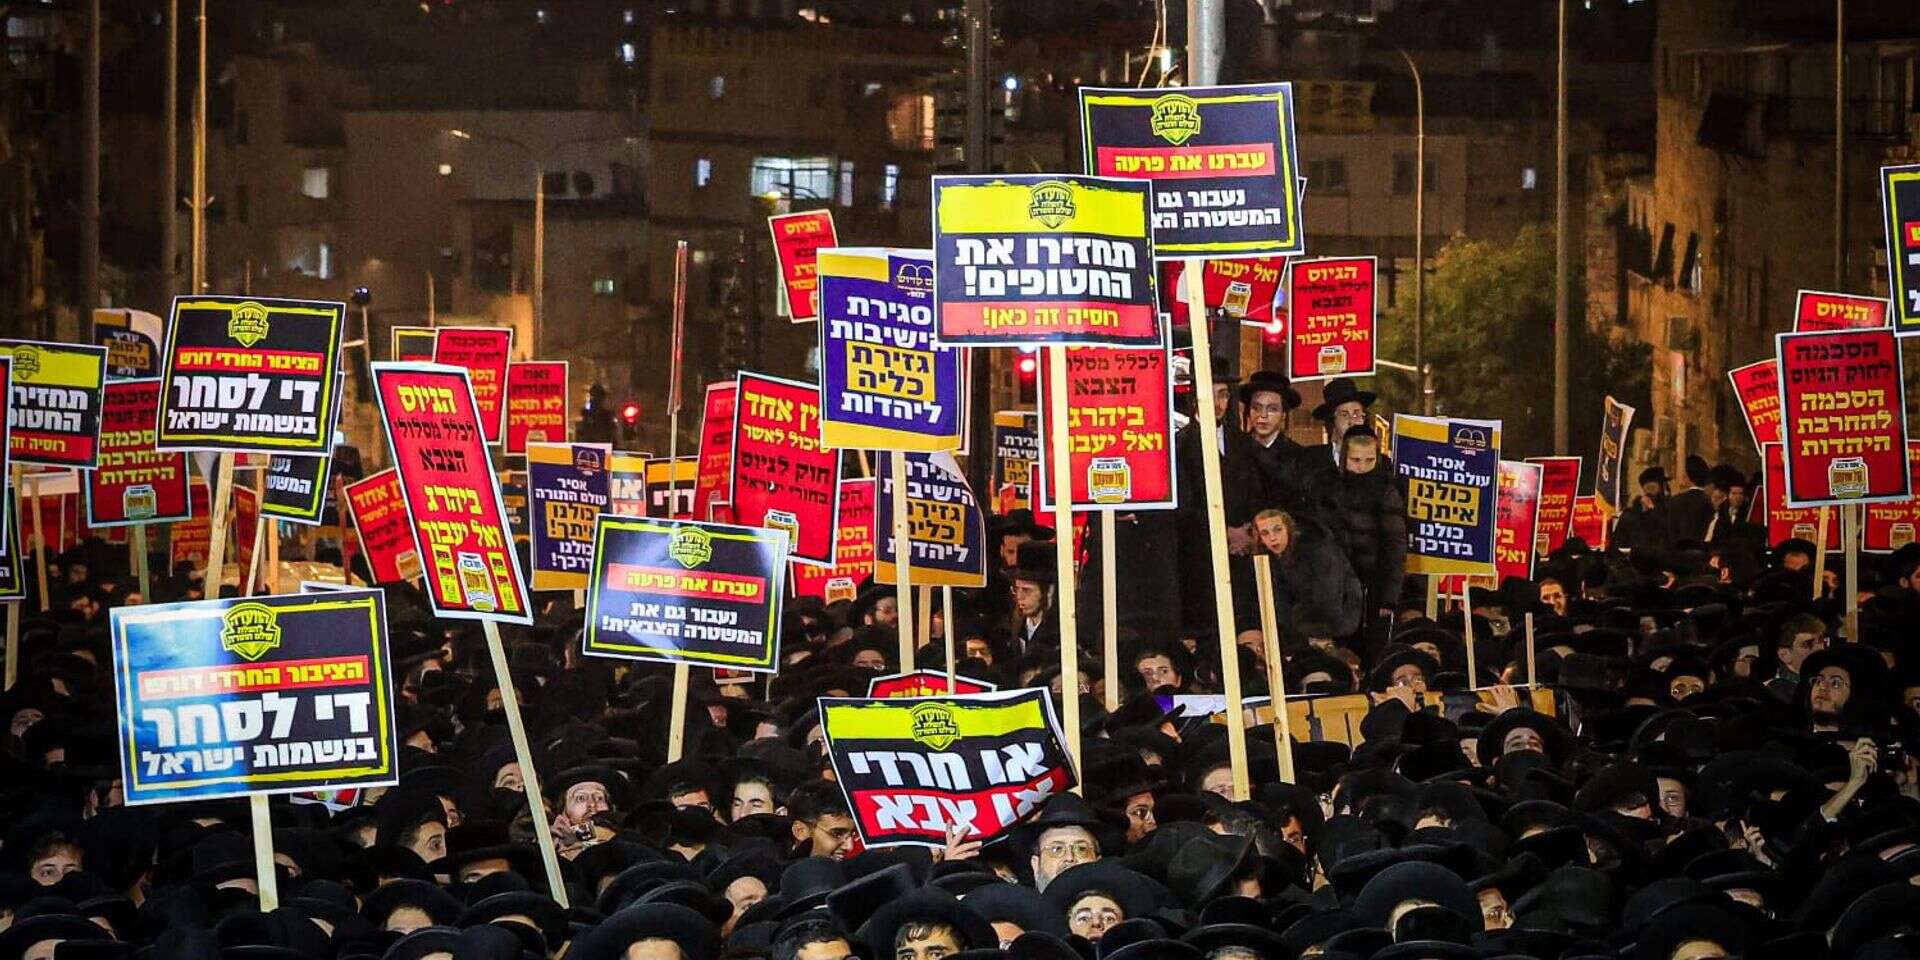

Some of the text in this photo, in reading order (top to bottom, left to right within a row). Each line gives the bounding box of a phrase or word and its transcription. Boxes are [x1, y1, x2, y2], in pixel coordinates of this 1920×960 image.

[1115, 152, 1266, 173] עברנו את פרעה
[1158, 189, 1245, 208] נעבור גם
[1183, 208, 1281, 229] המשטרה
[955, 238, 1137, 268] תחזירו את
[965, 265, 1133, 299] החטופים!
[1209, 260, 1278, 283] ואל יעבור
[1307, 265, 1360, 282] הגיוס
[847, 295, 932, 326] סגירת
[983, 307, 1119, 330] רוסיה זה כאן!
[1307, 312, 1358, 330] ביהרג
[1816, 302, 1870, 321] הגיוס
[1296, 329, 1369, 346] ואל יעבור
[179, 351, 320, 370] הציבור החרדי דורש
[852, 345, 930, 373] גזירת
[1066, 353, 1159, 372] לכלל מסלו
[1795, 341, 1879, 361] הסכמה
[859, 369, 924, 395] כליה
[1791, 360, 1892, 384] לחוק הגיוס
[173, 373, 270, 410] לסחר
[279, 380, 320, 412] די
[1074, 377, 1136, 395] הצבא
[397, 384, 457, 414] הגיוס
[543, 395, 562, 411] לא
[841, 392, 942, 424] ליהדות
[1801, 389, 1885, 412] הסכמה
[167, 409, 229, 430] ישראל
[744, 390, 820, 432] ין אחד
[1069, 405, 1145, 428] ביהרג
[1797, 410, 1892, 434] להחרבת
[233, 413, 317, 434] בנשמות
[394, 417, 475, 441] לכלל מסלולי
[29, 439, 66, 452] רוסיה
[101, 429, 155, 448] סכמה
[741, 423, 831, 454] יכול לאשר
[1004, 435, 1038, 448] גירת
[1069, 430, 1163, 454] ואל יעבו
[1801, 435, 1891, 456] היהדות
[419, 447, 468, 473] הצבא
[998, 446, 1038, 459] שיבות
[1427, 455, 1466, 471] אסיר
[100, 467, 176, 485] היהדות
[741, 450, 830, 484] חוק לגיוס
[1399, 463, 1490, 487] עולם התורה
[266, 475, 311, 494] המשט
[557, 478, 587, 492] אסיר
[1417, 481, 1472, 504] כולנו
[535, 488, 607, 506] עולם התורה
[553, 503, 594, 521] כולנו
[1412, 497, 1475, 522] איתך!
[418, 519, 469, 547] יעבור
[470, 520, 504, 549] ואל
[551, 519, 593, 541] יתך!
[1419, 522, 1464, 540] כולנו
[1409, 534, 1474, 556] בדרכך!
[1497, 545, 1527, 564] ואל
[551, 552, 591, 570] רכך!
[627, 571, 758, 597] עברנו את פרעה
[630, 602, 738, 626] נעבור גם את
[602, 615, 762, 646] המשטרה הצבאית!
[144, 661, 364, 694] הציבור החרדי דורש
[142, 692, 371, 748] די לסחר
[143, 737, 378, 776] בנשמות ישראל
[848, 742, 1050, 790] או חרדי
[871, 777, 1055, 836] או צבא
